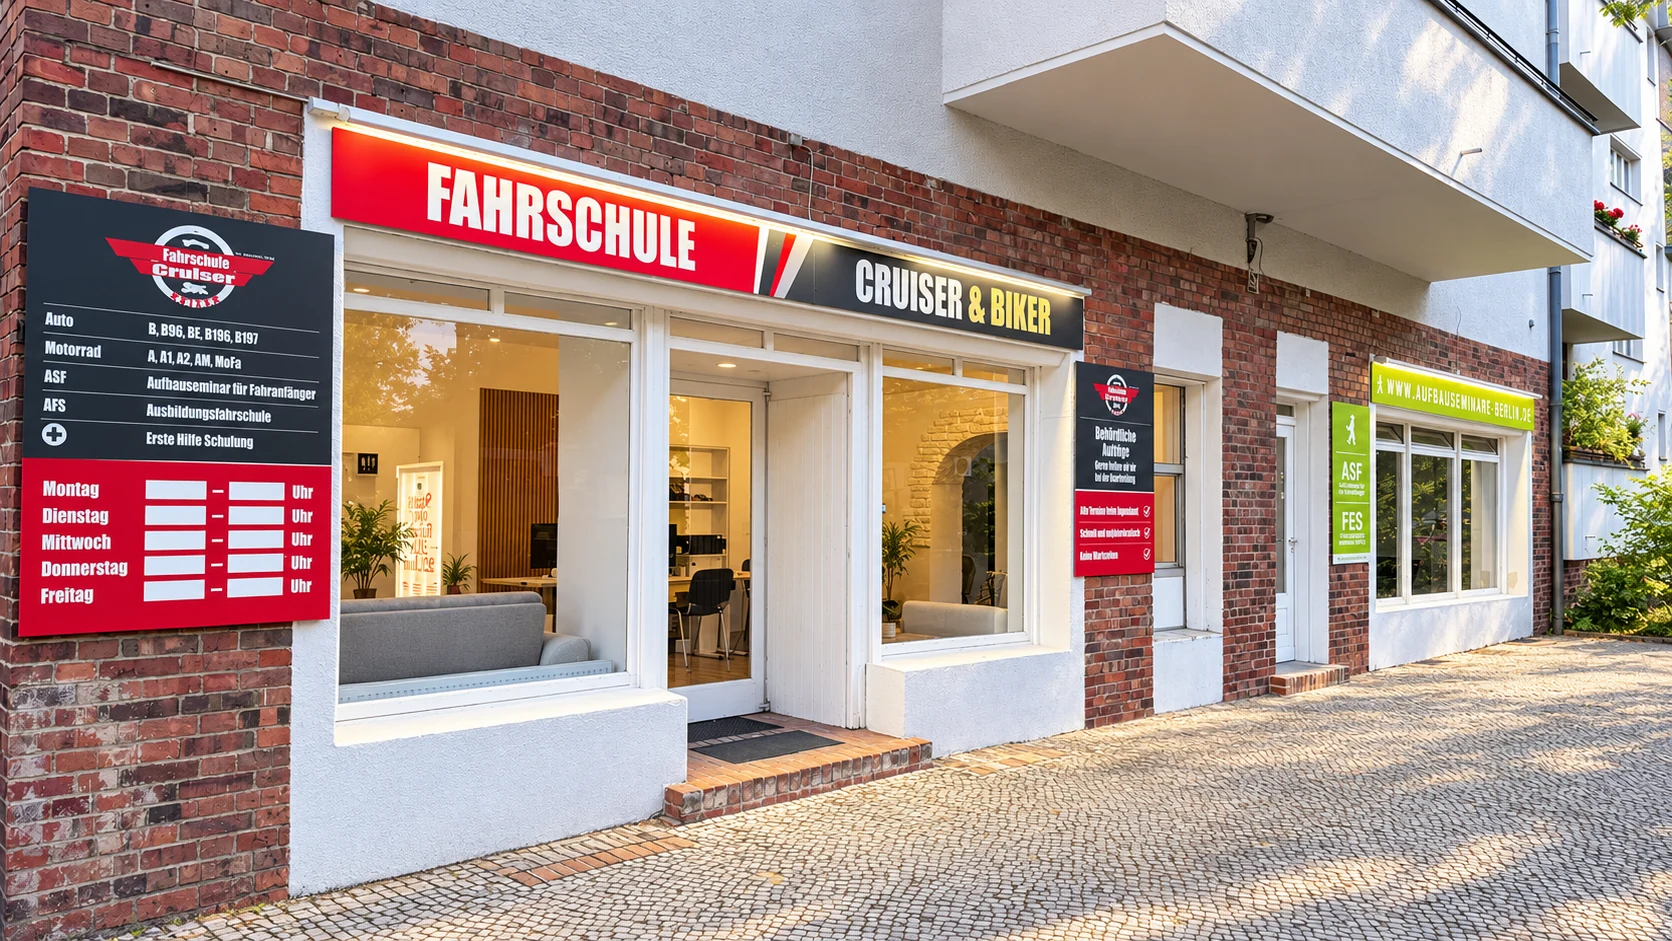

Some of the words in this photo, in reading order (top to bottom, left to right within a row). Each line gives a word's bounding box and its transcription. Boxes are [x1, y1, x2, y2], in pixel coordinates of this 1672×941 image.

[427, 162, 695, 271] FAHRSCHULE
[162, 248, 230, 270] Fahrschule
[855, 258, 962, 320] CRUISER
[968, 287, 986, 324] &
[990, 288, 1051, 336] BIKER
[45, 312, 73, 327] Auto
[149, 322, 159, 337] B,
[161, 324, 185, 339] B96,
[188, 326, 202, 340] BE,
[205, 328, 233, 343] B196,
[235, 331, 258, 344] B197
[45, 341, 101, 358] Motorrad
[148, 350, 157, 363] A,
[160, 351, 175, 365] A1,
[177, 352, 192, 366] A2,
[195, 354, 213, 368] AM,
[215, 355, 241, 369] MoFa
[44, 369, 66, 383] ASF
[147, 376, 231, 394] Aufbauseminar
[233, 383, 247, 395] für
[250, 384, 316, 401] Fahranfänger
[43, 398, 65, 412] AFS
[147, 402, 271, 423] Ausbildungsfahrschule
[147, 432, 174, 445] Erste
[177, 433, 202, 446] Hilfe
[204, 435, 253, 449] Schulung
[1342, 461, 1362, 481] ASF
[43, 481, 99, 498] Montag
[293, 485, 313, 499] Uhr
[43, 508, 108, 525] Dienstag
[292, 509, 313, 523] Uhr
[1342, 512, 1363, 531] FES
[42, 534, 111, 550] Mittwoch
[292, 532, 312, 546] Uhr
[42, 561, 127, 576] Donnerstag
[292, 555, 312, 570] Uhr
[41, 588, 93, 604] Freitag
[291, 579, 312, 593] Uhr
